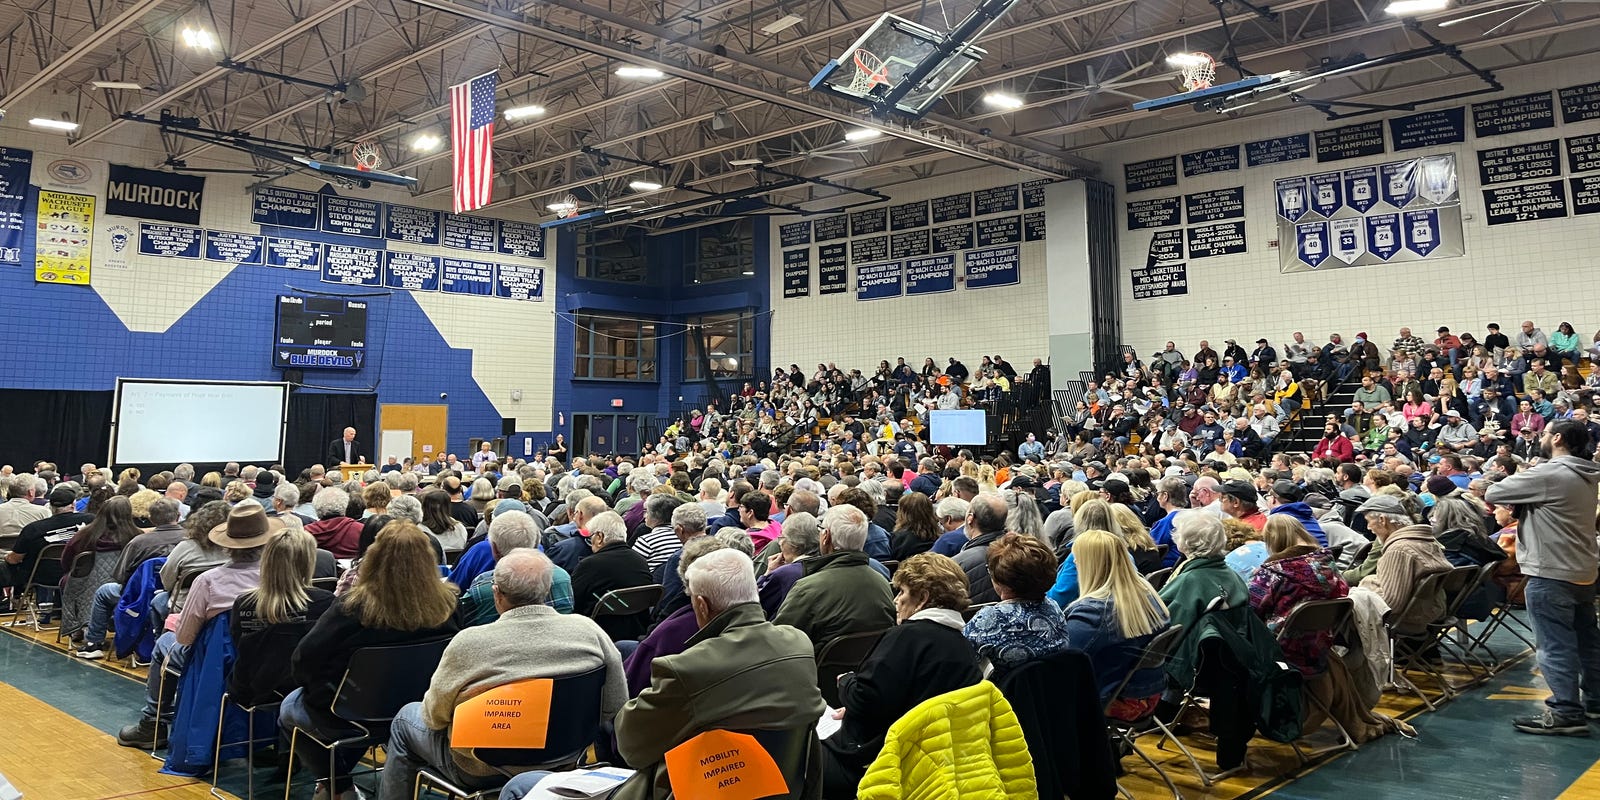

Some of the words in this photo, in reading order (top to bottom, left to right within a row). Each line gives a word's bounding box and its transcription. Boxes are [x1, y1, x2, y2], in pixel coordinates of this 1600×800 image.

[1561, 88, 1584, 97] GIRLS
[1502, 98, 1527, 106] ATHLETIC
[1529, 94, 1552, 102] LEAGUE
[1477, 111, 1498, 120] GIRLS
[1501, 102, 1548, 115] BASKETBALL
[1476, 111, 1552, 128] CO-CHAMPIONS
[1339, 130, 1379, 143] BASKETBALL
[1318, 138, 1382, 154] CO-CHAMPIONS
[1570, 145, 1592, 154] GIRLS
[1485, 149, 1508, 158] DISTRICT
[1204, 154, 1236, 164] BASKETBALL
[1483, 158, 1503, 167] GIRLS
[1506, 151, 1556, 163] BASKETBALL
[1526, 160, 1552, 169] LOSSES
[1128, 166, 1174, 178] CHAMPIONS
[1489, 168, 1553, 182] 1999-2000
[1142, 172, 1175, 182] BASKETBALL
[1523, 182, 1552, 191] SCHOOL
[48, 193, 88, 203] MIDLAND
[108, 180, 200, 211] MURDOCK
[275, 190, 298, 198] OUTDOOR
[1496, 190, 1552, 201] 2004-2005
[42, 198, 92, 208] WACHUSETT
[293, 200, 318, 208] LEAGUE
[349, 201, 376, 209] COUNTRY
[979, 196, 1012, 205] CHAMPIONS
[1205, 200, 1241, 208] BASKETBALL
[1512, 196, 1561, 205] BASKETBALL
[48, 204, 86, 213] LEAGUE
[261, 202, 311, 215] CHAMPIONS
[348, 208, 376, 216] CHAMPION
[1189, 208, 1221, 217] UNDEFEATED
[1489, 207, 1519, 216] LEAGUE
[1522, 202, 1564, 212] CHAMPIONS
[390, 216, 413, 225] INDOOR
[106, 224, 134, 237] MURDOCK
[394, 223, 432, 232] CHAMPION
[502, 232, 522, 240] INDOOR
[1197, 230, 1236, 238] 2004-2005
[1207, 234, 1243, 242] BASKETBALL
[153, 240, 188, 248] CHAMPION
[504, 238, 538, 247] CHAMPION
[1214, 239, 1244, 248] CHAMPIONS
[354, 248, 378, 257] ALLARD
[327, 257, 353, 265] INDOOR
[966, 259, 990, 267] MID-WACH
[331, 263, 374, 273] CHAMPION
[389, 263, 413, 272] INDOOR
[934, 264, 953, 272] LEAGUE
[971, 263, 1013, 273] CHAMPIONS
[1150, 266, 1184, 276] BASKETBALL
[328, 269, 352, 277] LONG
[393, 270, 432, 279] CHAMPION
[910, 271, 949, 280] CHAMPIONS
[462, 274, 490, 283] CHAMPIONS
[862, 277, 897, 286] CHAMPIONS
[1140, 274, 1171, 284] MID-WACH
[503, 281, 537, 290] CHAMPION
[1134, 281, 1169, 291] SPORTSMANSHIP
[290, 354, 318, 365] BLUE
[318, 356, 353, 367] DEVILS
[700, 749, 740, 767] MOBILITY
[704, 761, 746, 779] IMPAIRED
[718, 776, 741, 789] AREA
